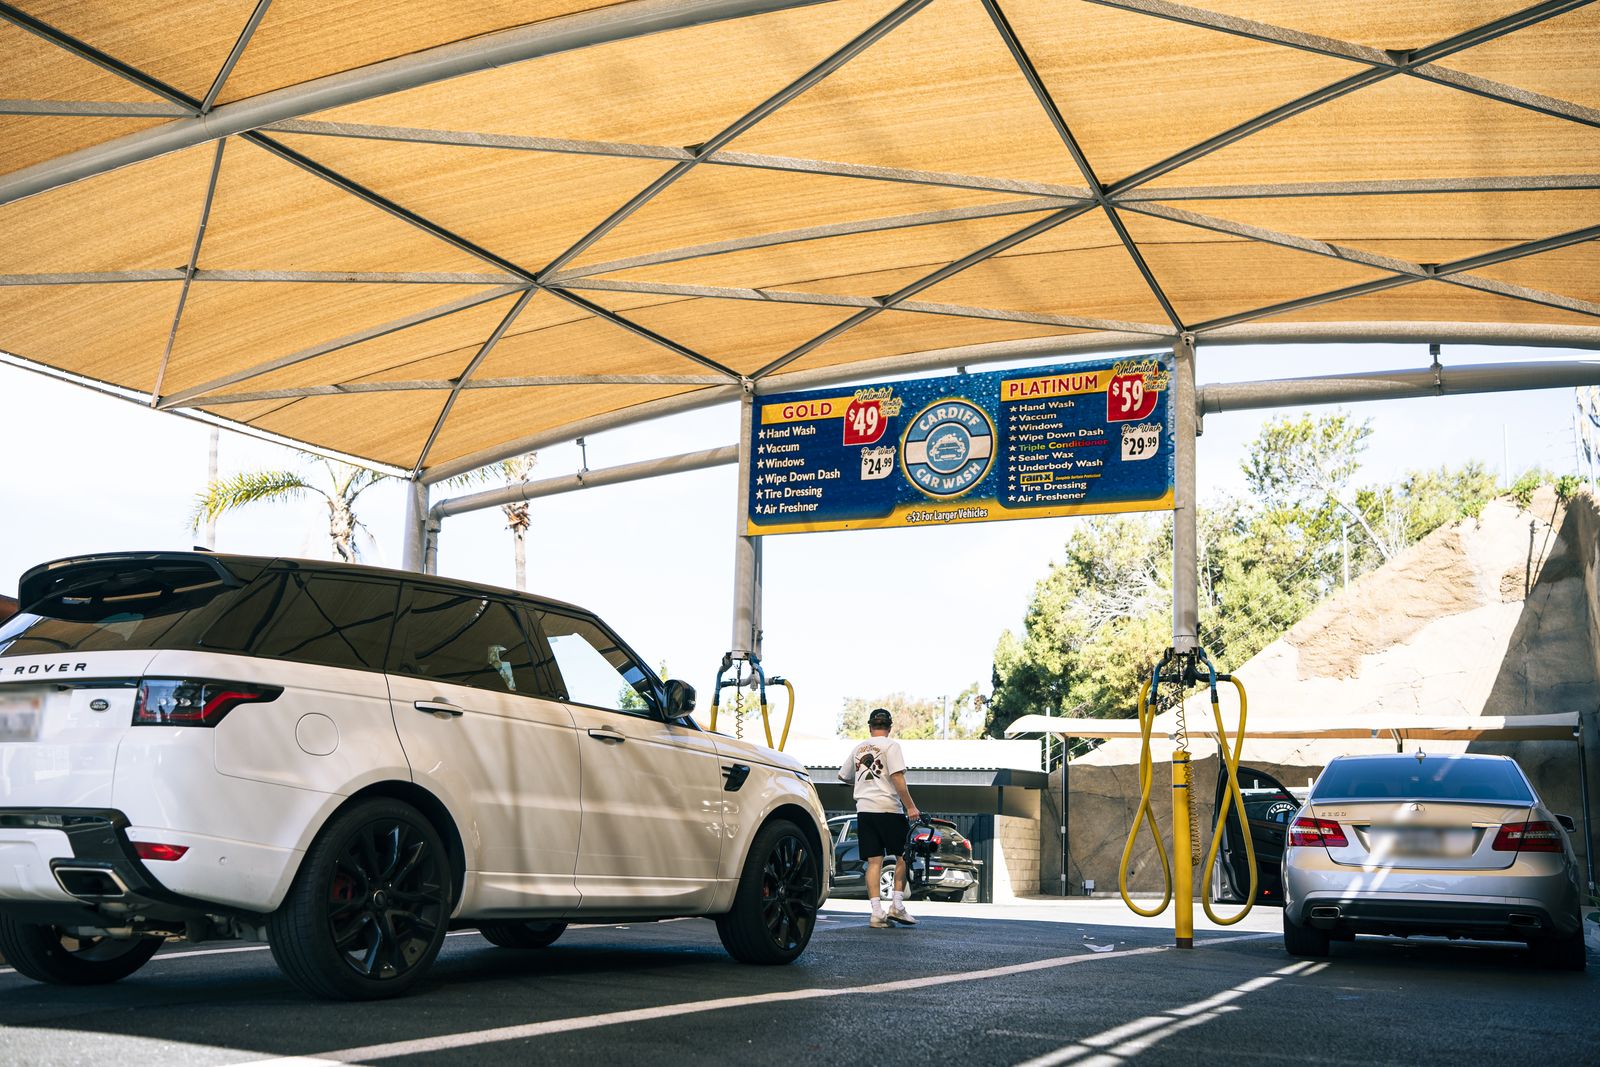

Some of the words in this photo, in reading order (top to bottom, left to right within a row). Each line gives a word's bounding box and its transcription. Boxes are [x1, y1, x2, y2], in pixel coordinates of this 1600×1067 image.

[1114, 361, 1157, 375] Unlimited
[1009, 374, 1098, 397] PLATINUM
[855, 387, 893, 402] Unlimited
[1112, 379, 1143, 412] $59
[782, 402, 832, 419] GOLD
[1019, 402, 1046, 412] Hand
[1048, 400, 1074, 409] Wash
[848, 406, 878, 436] $49
[919, 406, 981, 431] CARDIFF
[1019, 413, 1057, 422] Vaccum
[766, 427, 790, 439] Hand
[792, 425, 816, 436] Wash
[1019, 422, 1063, 432] Windows
[1122, 424, 1137, 435] Per
[1139, 422, 1162, 433] Wash
[1018, 433, 1044, 444] Wipe
[1046, 431, 1076, 440] Down
[1078, 428, 1104, 437] Dash
[765, 443, 800, 454] Vaccum
[861, 447, 874, 457] Per
[875, 445, 896, 455] Wash
[1019, 443, 1046, 453] Triple
[1048, 439, 1108, 450] Conditioner
[1123, 436, 1157, 456] $29.99
[765, 457, 805, 468] Windows
[1018, 453, 1049, 463] Sealer
[1052, 451, 1074, 460] Wax
[863, 457, 892, 475] $24.99
[1018, 461, 1073, 472] Underbody
[1076, 459, 1103, 468] Wash
[765, 473, 787, 485] Wipe
[789, 471, 816, 481] Down
[817, 468, 840, 480] Dash
[916, 468, 941, 488] CAR
[942, 462, 981, 489] WASH
[764, 489, 782, 499] Tire
[784, 486, 823, 498] Dressing
[1021, 484, 1041, 493] Tire
[1043, 481, 1087, 491] Dressing
[1017, 494, 1033, 503] Air
[1035, 491, 1086, 502] Freshener
[763, 504, 777, 514] Air
[779, 502, 818, 513] Freshner
[906, 512, 920, 523] +$2
[921, 511, 933, 521] For
[934, 510, 957, 522] Larger
[958, 507, 988, 519] Vehicles
[14, 663, 87, 675] ROVER
